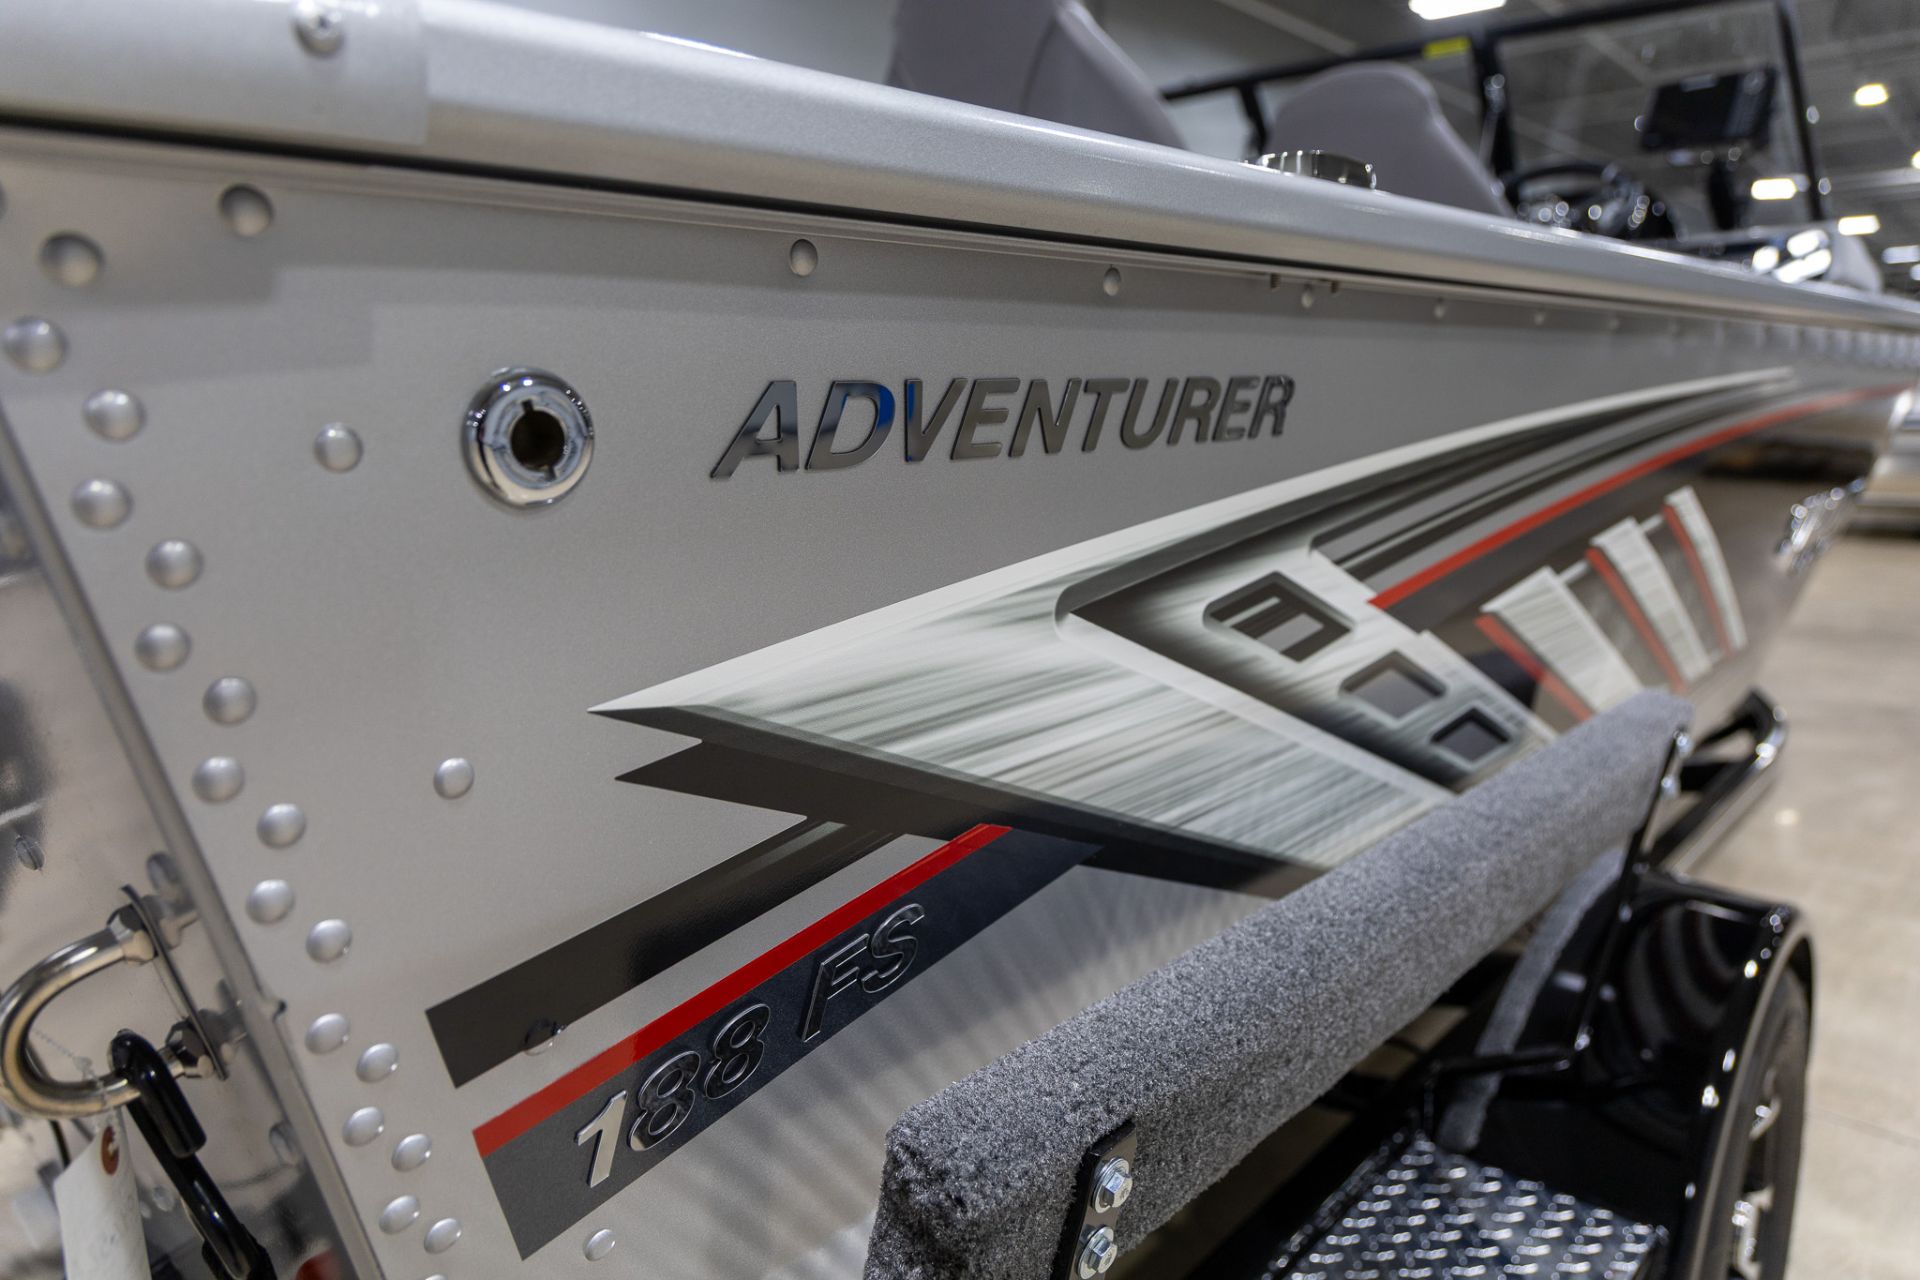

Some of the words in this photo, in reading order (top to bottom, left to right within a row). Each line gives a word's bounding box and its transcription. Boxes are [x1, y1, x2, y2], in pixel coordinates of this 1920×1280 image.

[709, 374, 1296, 480] ADVENTURER
[575, 1003, 771, 1189] 188
[800, 903, 926, 1043] FS
